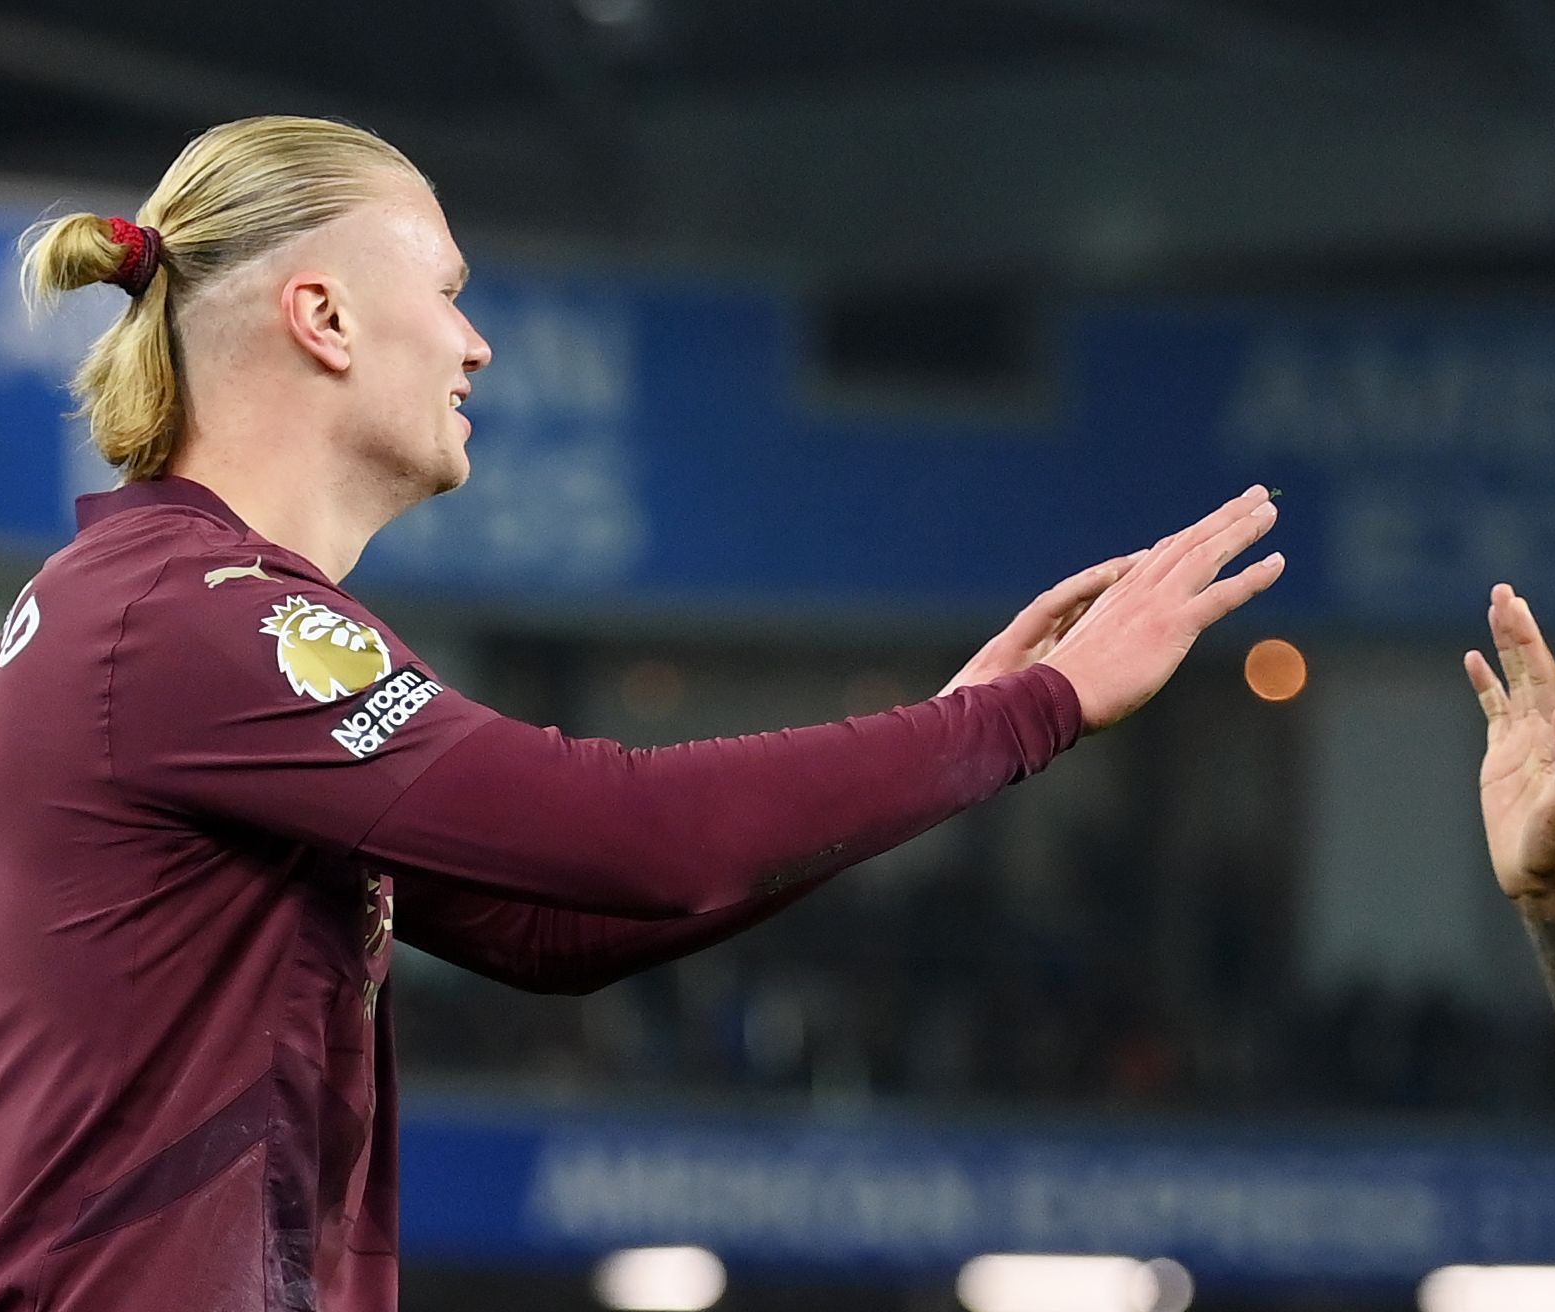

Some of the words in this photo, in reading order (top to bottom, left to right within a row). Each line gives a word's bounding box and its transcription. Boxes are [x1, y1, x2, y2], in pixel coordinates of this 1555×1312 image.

[331, 712, 372, 748] No
[365, 671, 422, 718] room
[348, 725, 384, 758] for
[378, 680, 444, 734] racism
